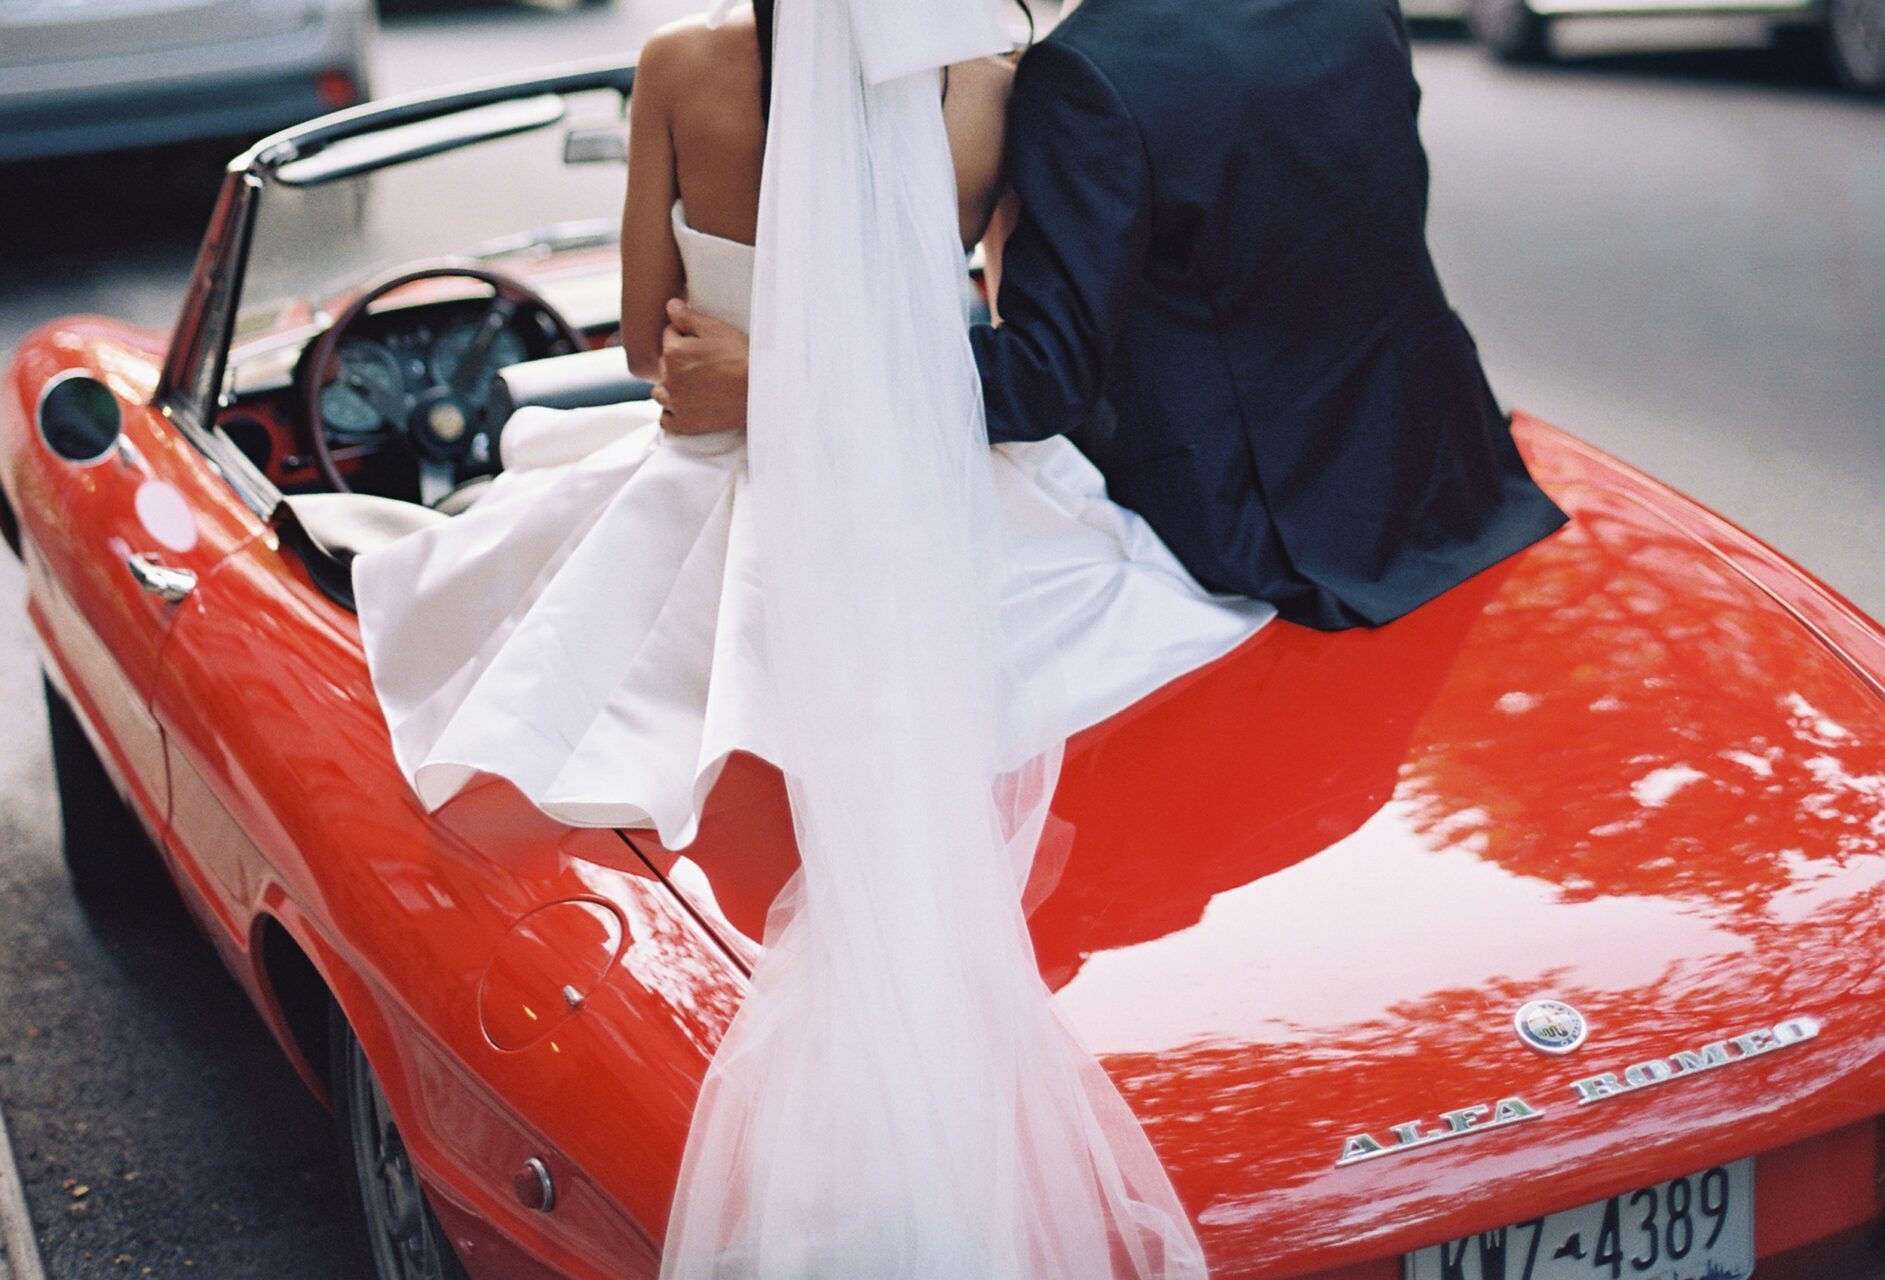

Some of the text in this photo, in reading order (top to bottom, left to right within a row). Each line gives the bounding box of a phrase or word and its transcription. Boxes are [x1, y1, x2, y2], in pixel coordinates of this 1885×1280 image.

[1335, 1096, 1545, 1167] ALFA
[1570, 1016, 1820, 1105] ROMEO
[1594, 1166, 1729, 1279] 4389
